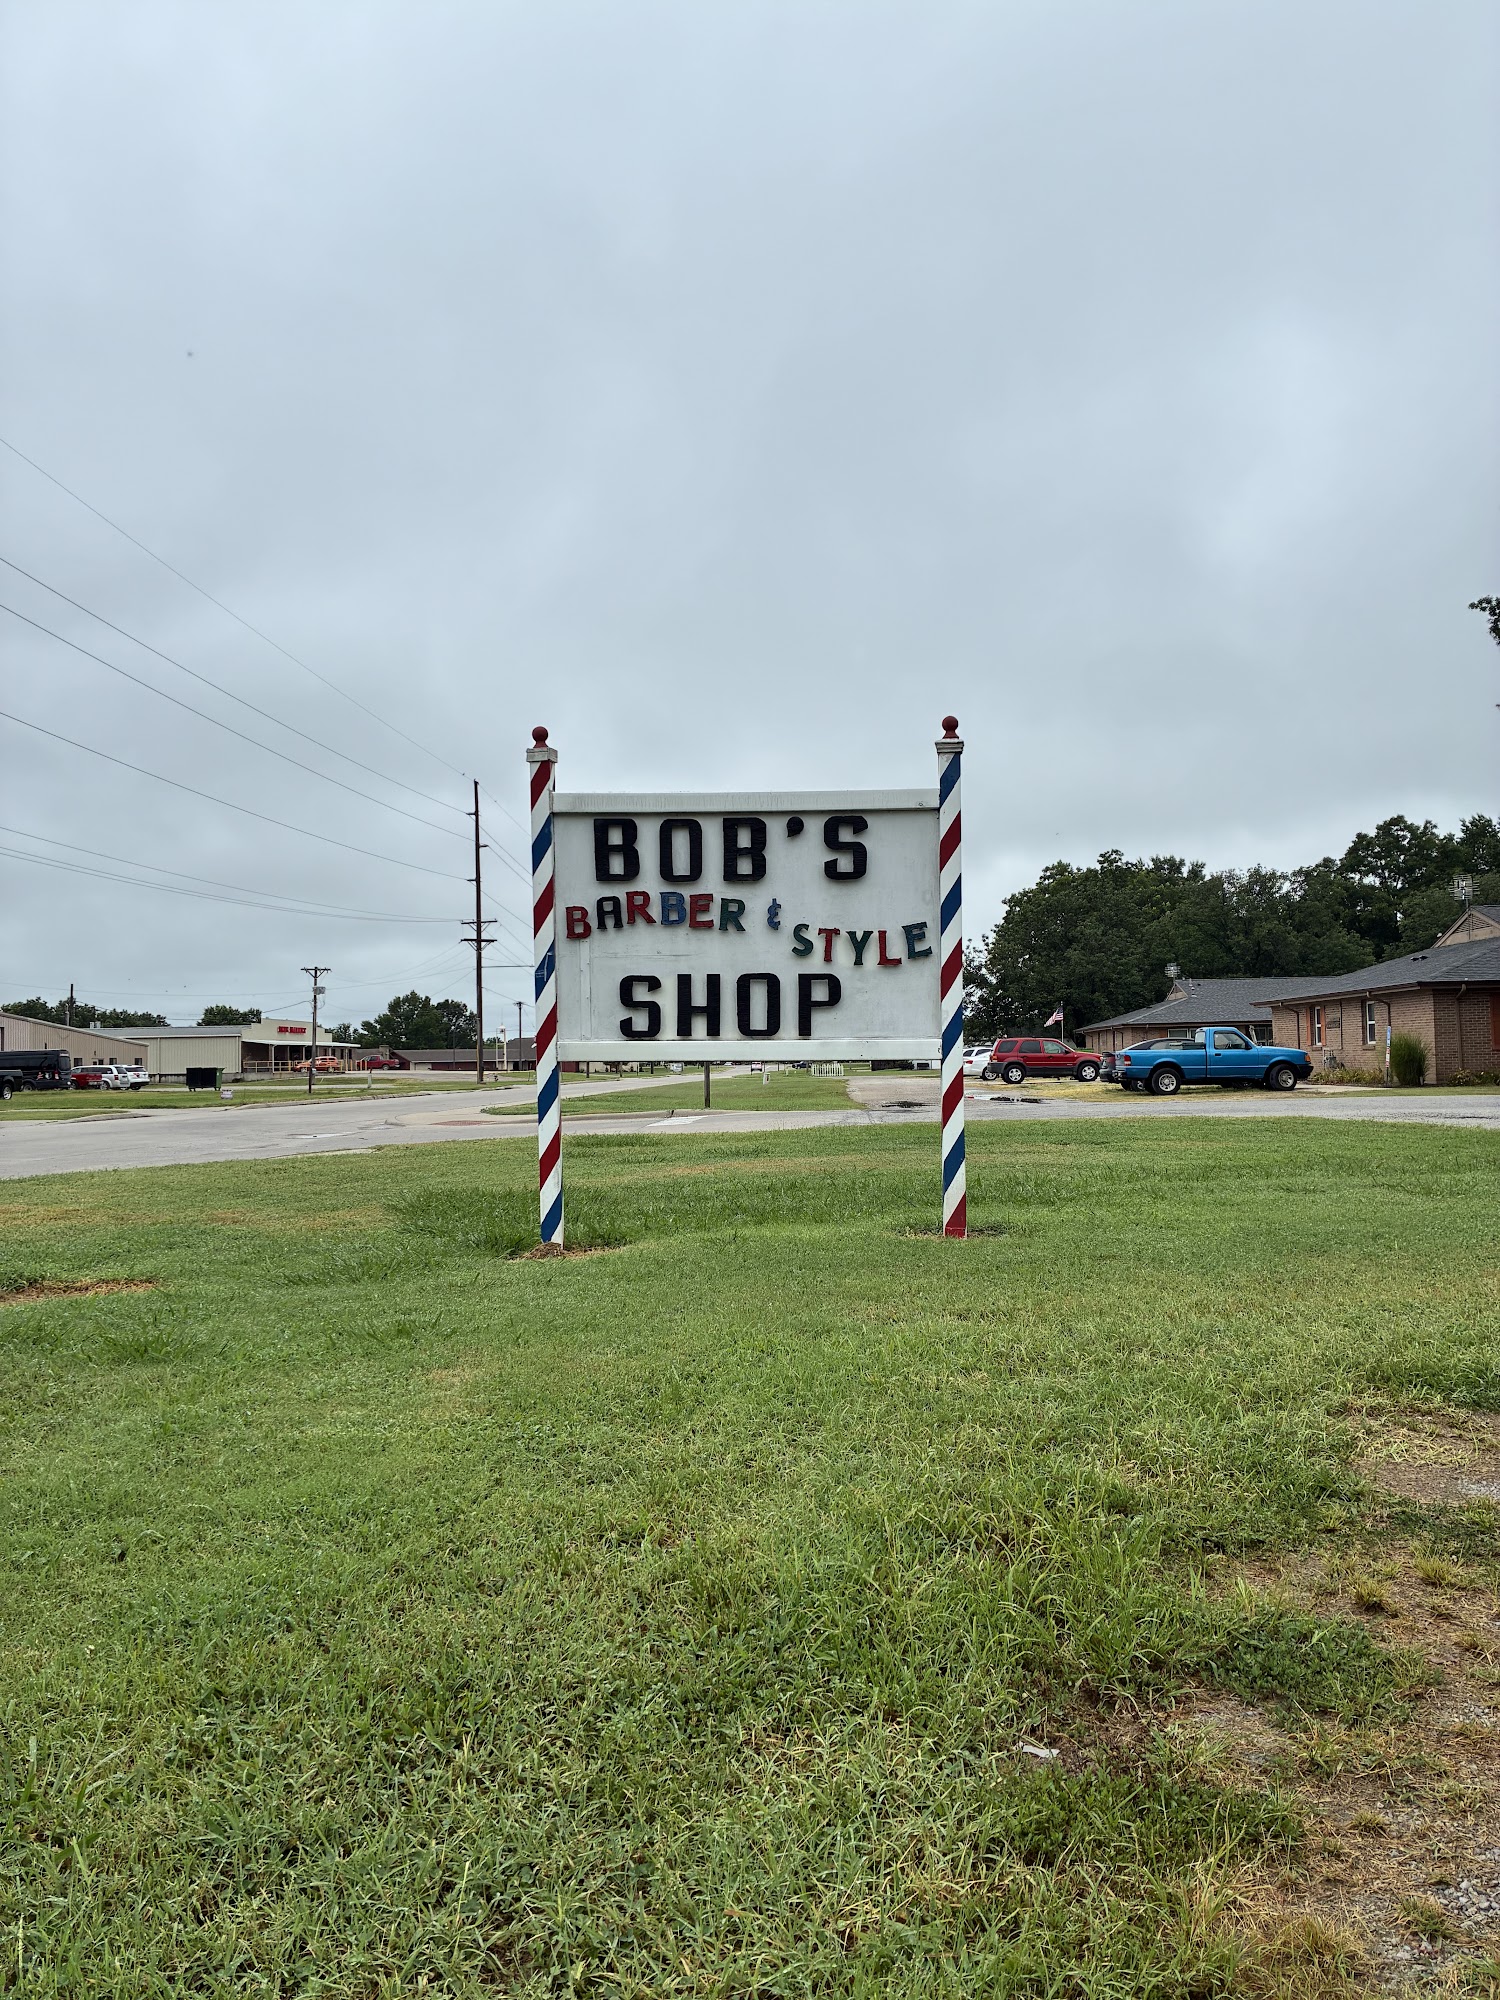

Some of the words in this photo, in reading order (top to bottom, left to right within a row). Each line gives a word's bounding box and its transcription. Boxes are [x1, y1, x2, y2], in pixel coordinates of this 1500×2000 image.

[593, 815, 868, 882] BOB'S
[565, 890, 746, 940] BARBER
[767, 897, 782, 931] &
[791, 921, 933, 966] STYLE
[619, 972, 842, 1038] SHOP
